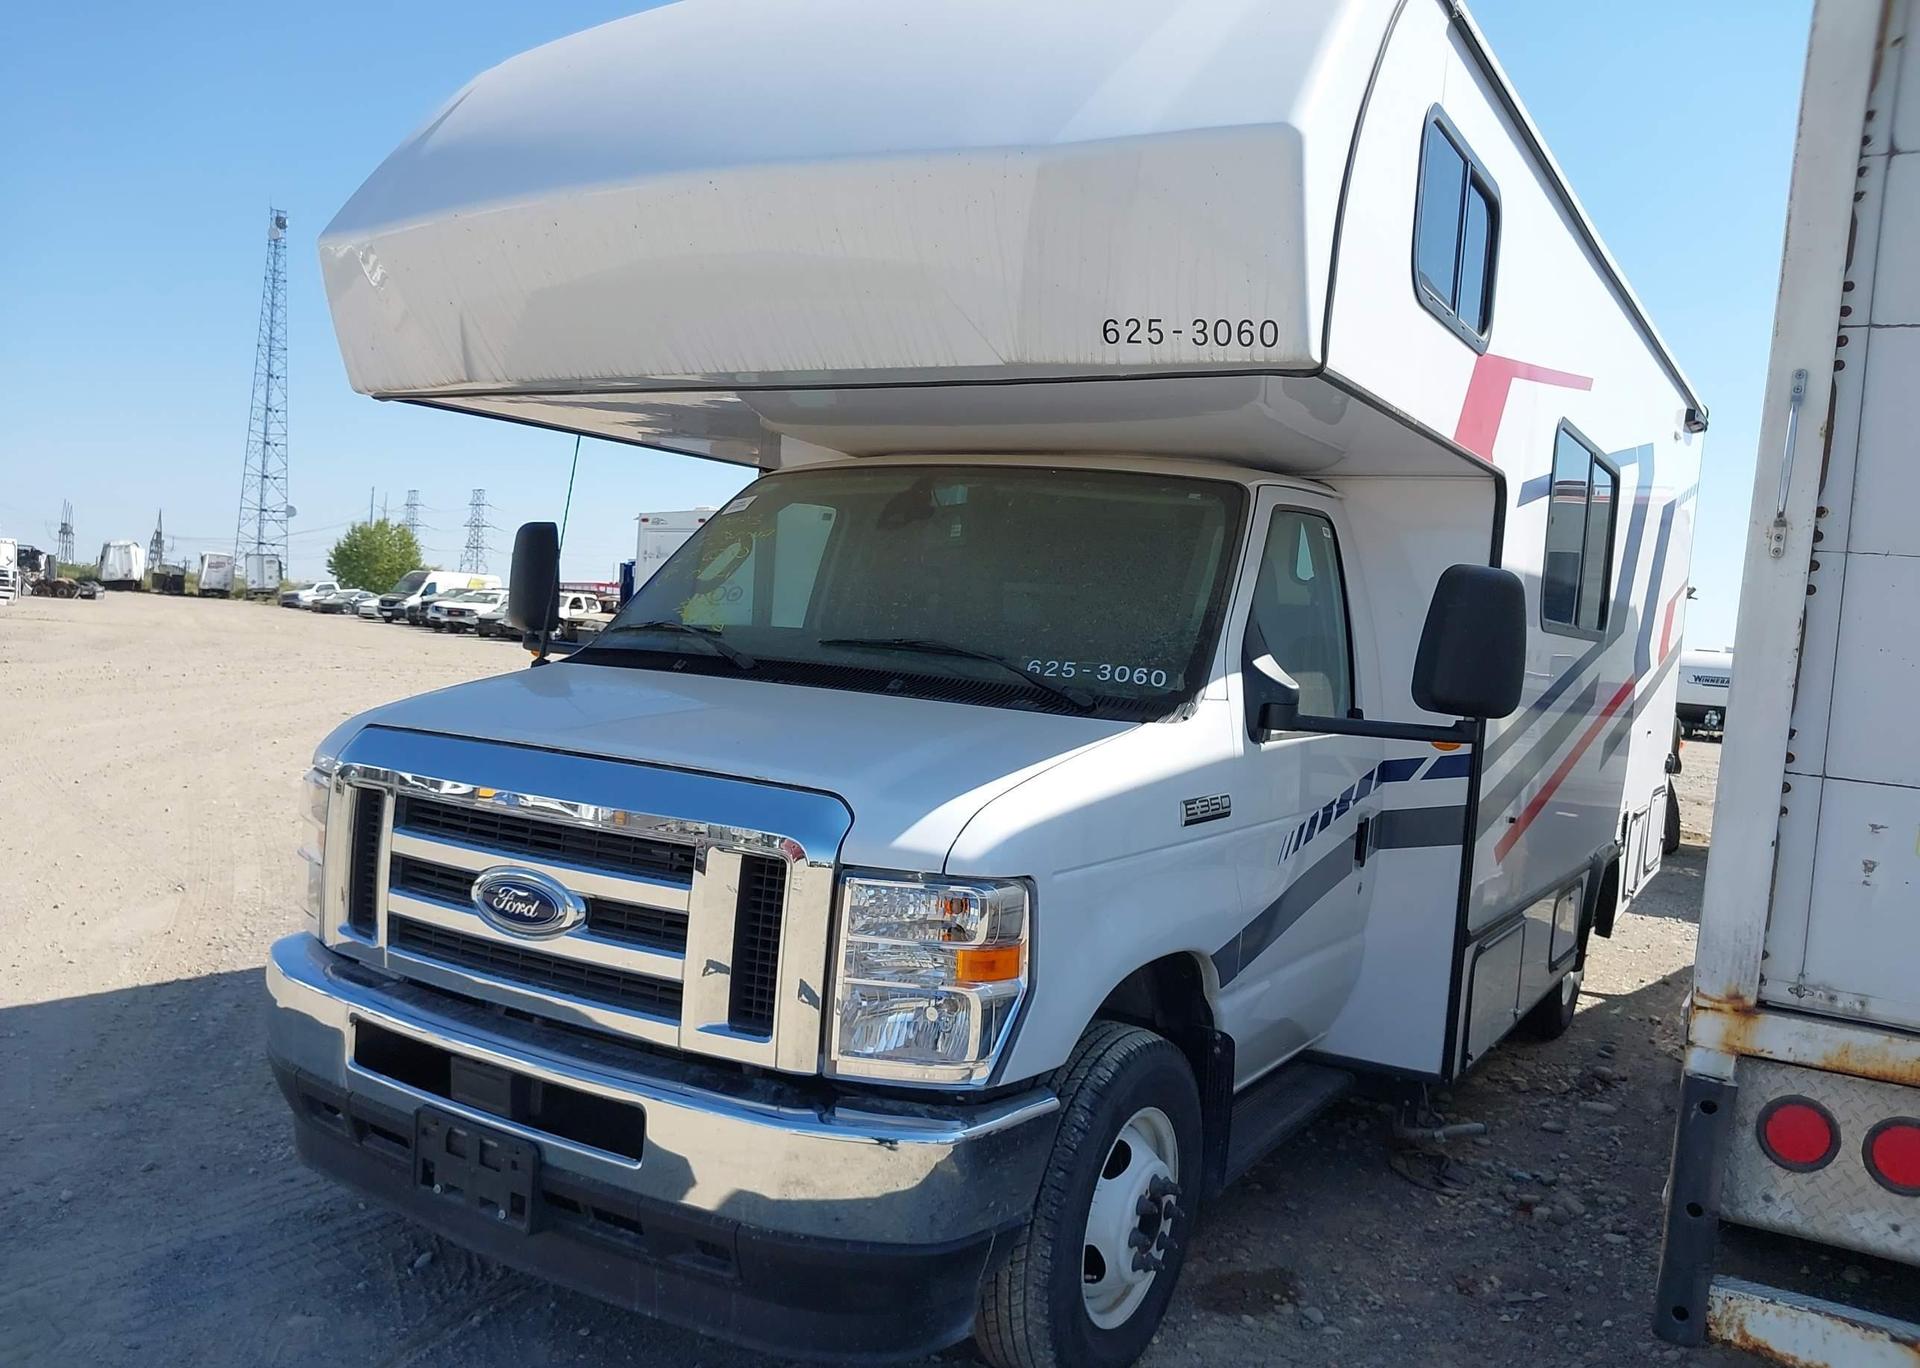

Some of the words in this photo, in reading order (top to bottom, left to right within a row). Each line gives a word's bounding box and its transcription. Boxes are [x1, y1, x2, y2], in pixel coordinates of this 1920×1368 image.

[1102, 318, 1279, 348] 625-3060
[1026, 659, 1167, 687] 625-3060
[492, 886, 540, 918] Ford
